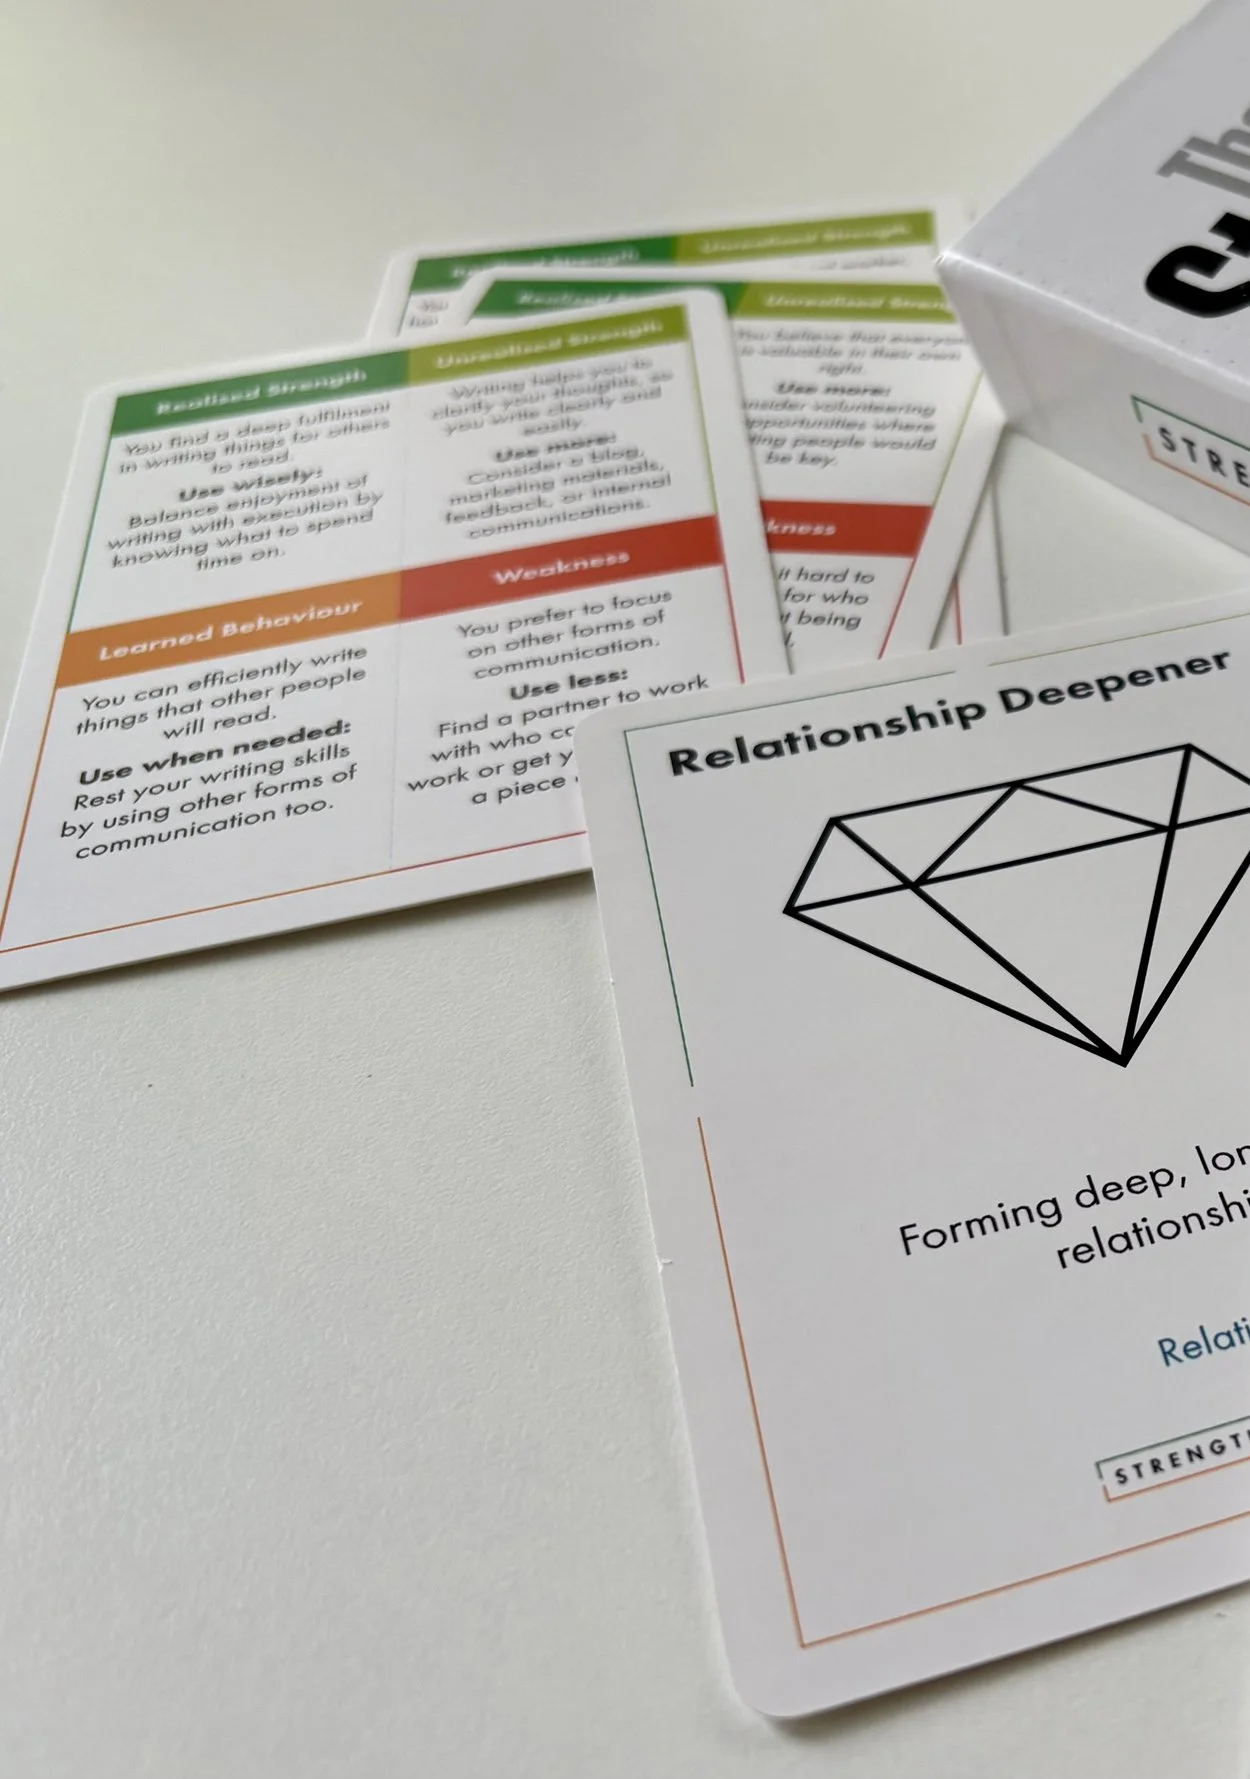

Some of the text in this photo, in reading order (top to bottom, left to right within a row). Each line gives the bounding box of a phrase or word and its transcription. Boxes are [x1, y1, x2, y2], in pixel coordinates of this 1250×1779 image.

[494, 553, 628, 584] Weakness
[796, 566, 850, 584] hard
[854, 571, 876, 585] to
[456, 591, 672, 638] You prefer to focus
[784, 587, 870, 606] for who
[797, 609, 862, 631] being
[99, 603, 359, 660] Learned Behaviour
[466, 608, 664, 659] on other forms of
[82, 648, 367, 712] You can efficiently write
[473, 637, 660, 679] communication.
[76, 666, 366, 735] things that other people
[437, 673, 709, 738] Find a partner to work
[509, 669, 628, 700] Use less:
[163, 704, 276, 739] will read.
[669, 649, 1231, 776] Relationship Deepener
[79, 719, 351, 785] Use when needed:
[430, 740, 480, 762] with
[488, 731, 542, 750] who
[73, 743, 350, 811] Rest your writing skills
[407, 766, 469, 791] work
[477, 763, 505, 778] or
[511, 752, 551, 776] get
[471, 776, 566, 804] a piece
[60, 762, 357, 839] by using other forms of
[75, 799, 333, 859] communication too.
[899, 1197, 1063, 1256] Forming
[1074, 1174, 1187, 1209] deep,
